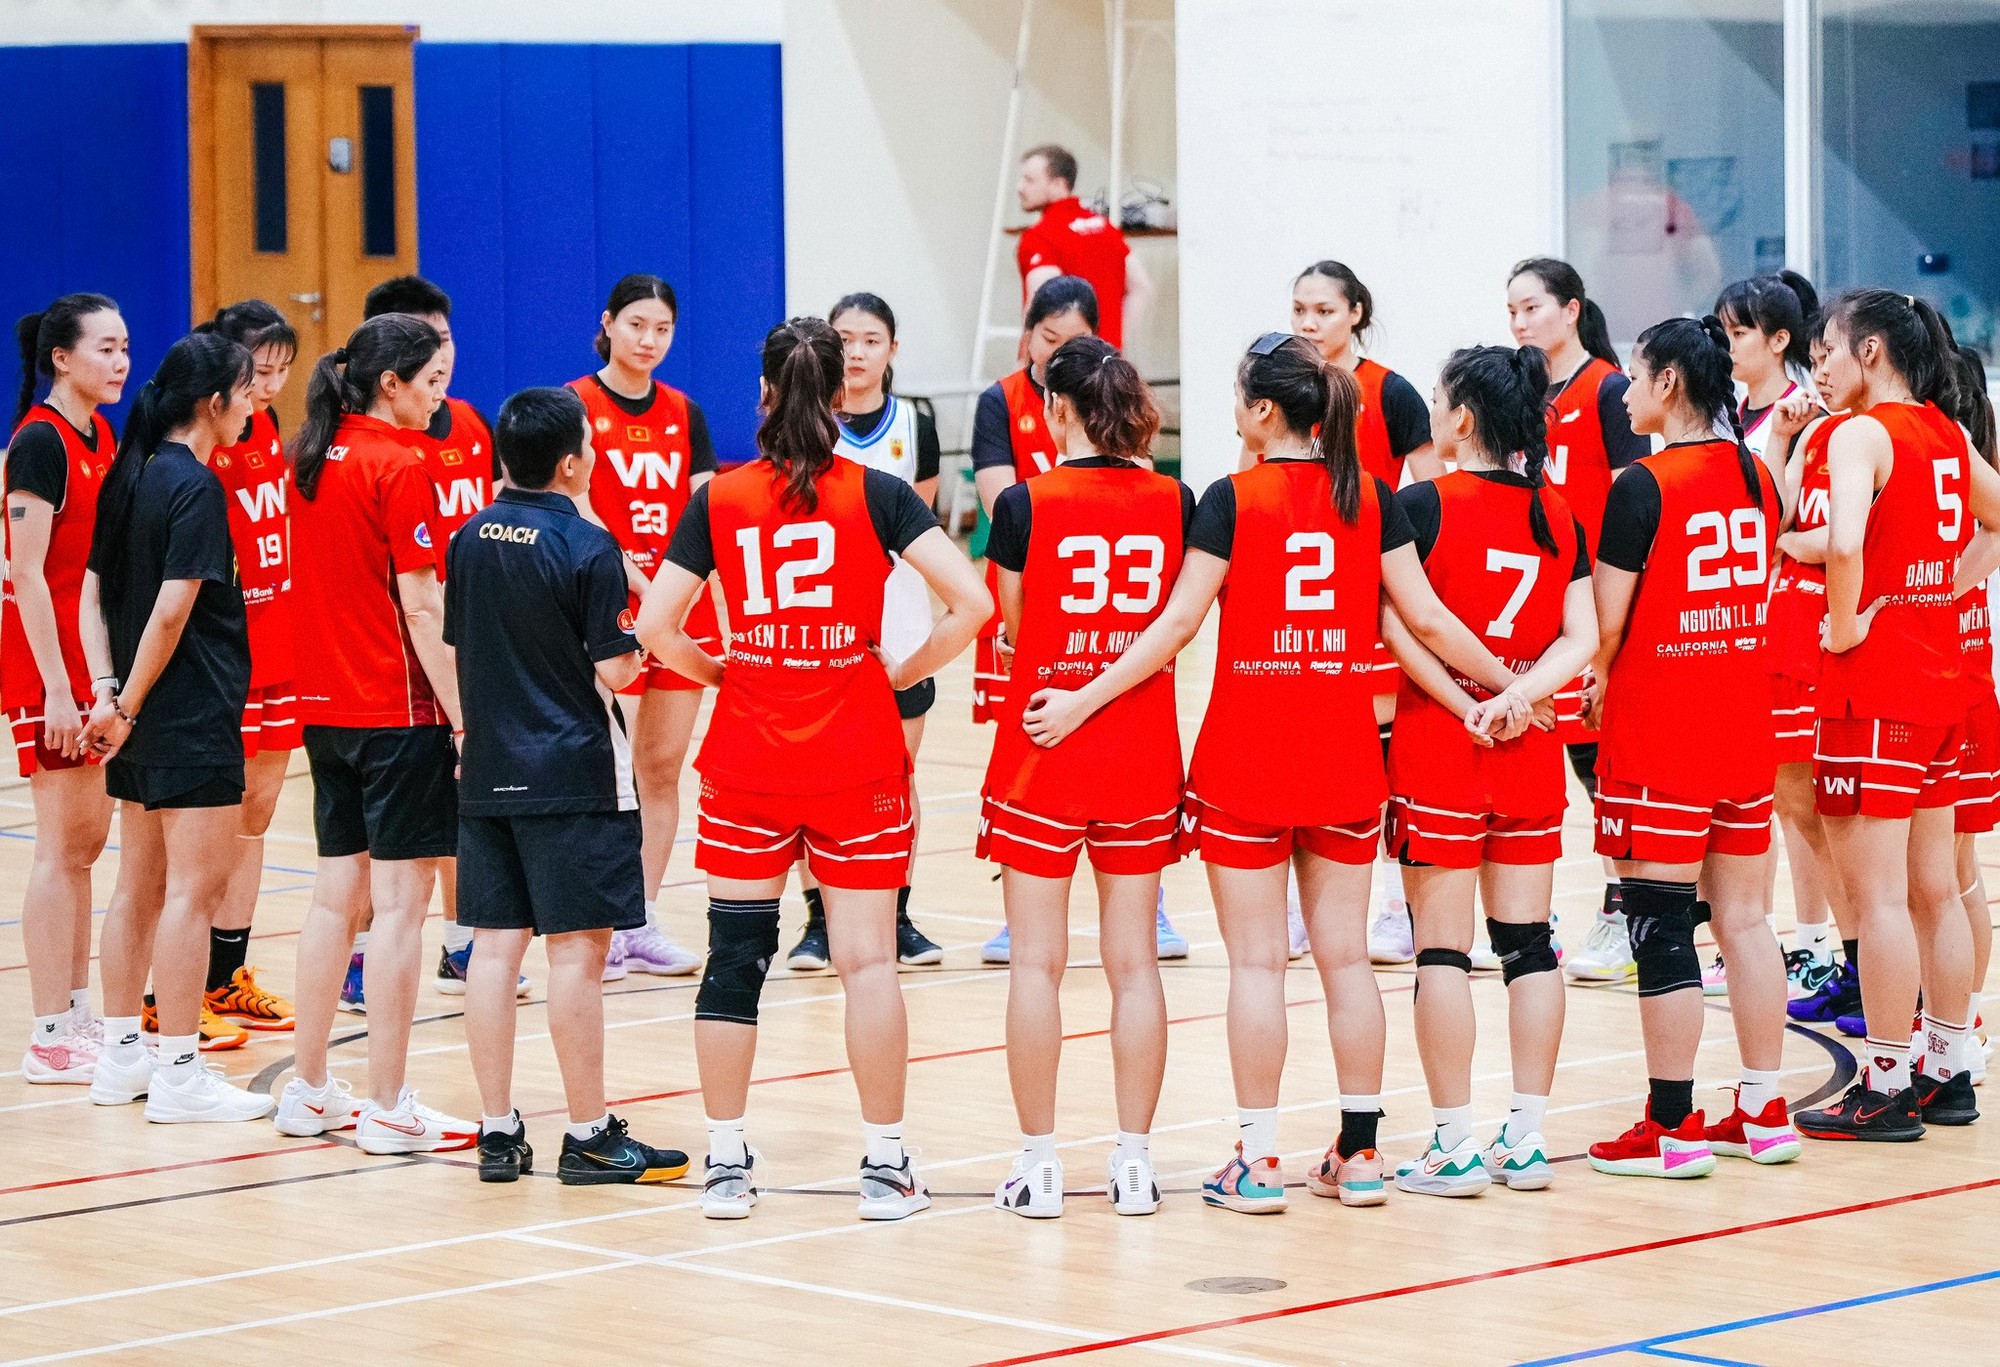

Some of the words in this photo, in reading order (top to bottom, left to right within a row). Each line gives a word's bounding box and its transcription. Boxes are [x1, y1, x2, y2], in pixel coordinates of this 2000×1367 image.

[606, 449, 682, 490] VN
[235, 477, 288, 523] VN
[435, 477, 485, 517] VN
[1932, 457, 1962, 541] 5
[479, 523, 540, 545] COACH
[629, 500, 669, 536] 23
[257, 533, 283, 568] 19
[736, 520, 835, 616] 12
[1686, 507, 1767, 592] 29
[1057, 534, 1165, 614] 33
[1285, 532, 1335, 611] 2
[1485, 548, 1541, 639] 7
[780, 624, 794, 649] T.
[800, 625, 814, 650] T.
[1307, 629, 1319, 653] Y.
[1323, 628, 1346, 653] NHI
[1656, 640, 1728, 653] CALIFORNIA
[1233, 660, 1302, 670] CALIFORNIA
[1823, 776, 1855, 795] VN
